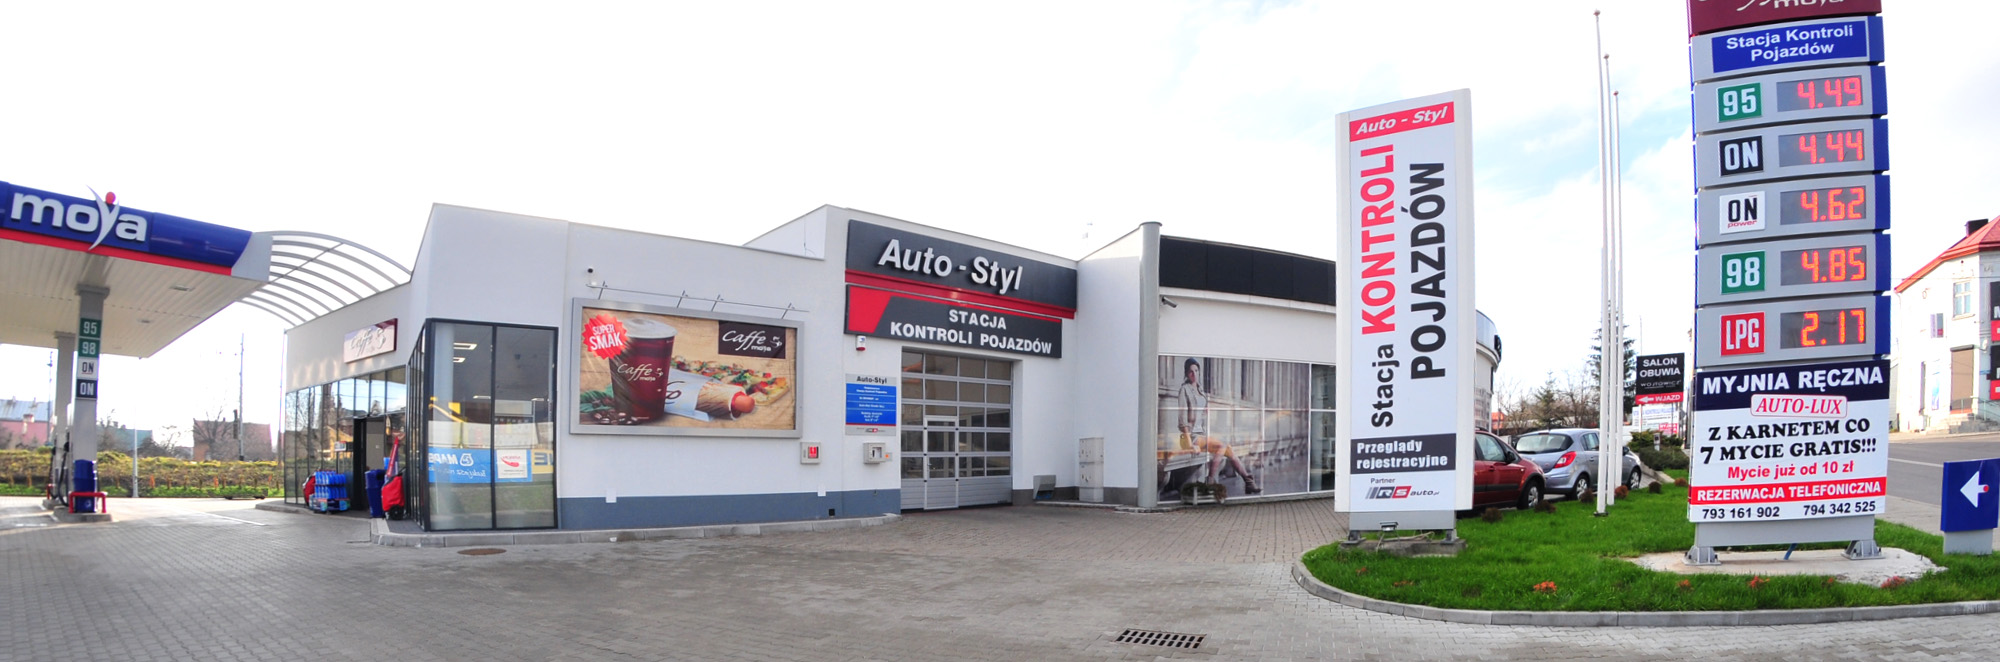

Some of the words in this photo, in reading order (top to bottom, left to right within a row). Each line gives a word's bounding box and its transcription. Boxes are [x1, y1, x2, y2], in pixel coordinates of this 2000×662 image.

[1726, 33, 1781, 50] Stacja
[1786, 24, 1853, 42] Kontroli
[1750, 41, 1834, 61] Pojazdów
[1722, 87, 1757, 116] 95
[1796, 77, 1863, 110] 4.49
[1355, 114, 1397, 136] Auto
[1412, 105, 1449, 125] Styl
[1724, 141, 1758, 171] ON
[1799, 130, 1864, 164] 4.44
[1727, 196, 1758, 223] ON
[1800, 186, 1865, 222] 4.62
[10, 184, 148, 251] moya
[1727, 219, 1758, 229] power
[1360, 143, 1396, 335] KONTROLI
[878, 238, 953, 278] Auto
[971, 255, 1023, 295] Styl
[1400, 162, 1446, 380] POJAZDÓW
[1725, 257, 1760, 288] 98
[1801, 247, 1866, 283] 4.85
[83, 321, 97, 335] 95
[592, 324, 615, 336] SUPER
[949, 309, 1007, 330] STACJA
[1725, 318, 1760, 350] LPG
[1800, 309, 1865, 347] 2.17
[82, 341, 96, 355] 98
[589, 332, 623, 351] SMAK
[722, 330, 767, 351] Caffe
[890, 322, 973, 345] KONTROLI
[980, 332, 1052, 354] POJAZDÓW
[81, 361, 95, 373] ON
[617, 363, 653, 382] Caffe
[1639, 367, 1681, 378] OBUWIA
[1643, 357, 1678, 367] SALON
[80, 382, 94, 396] ON
[856, 375, 888, 385] Auto-Styl
[1371, 344, 1400, 428] Stacja
[1702, 373, 1790, 395] MYJNIA
[1798, 366, 1884, 391] RĘCZNA
[1655, 394, 1681, 402] WJAZD
[1755, 397, 1845, 415] AUTO-LUX
[1708, 427, 1721, 441] Z
[1727, 420, 1840, 440] KARNETEM
[1845, 418, 1870, 433] CO
[1356, 439, 1423, 454] Przeglądy
[1700, 446, 1715, 464] 7
[1720, 443, 1785, 461] MYCIE
[1790, 438, 1877, 457] GRATIS!!!
[1356, 454, 1448, 469] rejestracyjne
[1728, 463, 1770, 481] Mycie
[1774, 463, 1795, 480] już
[1800, 462, 1818, 475] od
[1822, 461, 1837, 474] 10
[1842, 460, 1854, 473] zł
[1697, 487, 1785, 502] REZERWACJA
[1788, 481, 1881, 499] TELEFONICZNA
[1702, 508, 1725, 520] 793
[1729, 507, 1752, 519] 161
[1757, 506, 1780, 518] 902
[1803, 504, 1826, 516] 794
[1830, 503, 1851, 514] 342
[1854, 501, 1876, 513] 525
